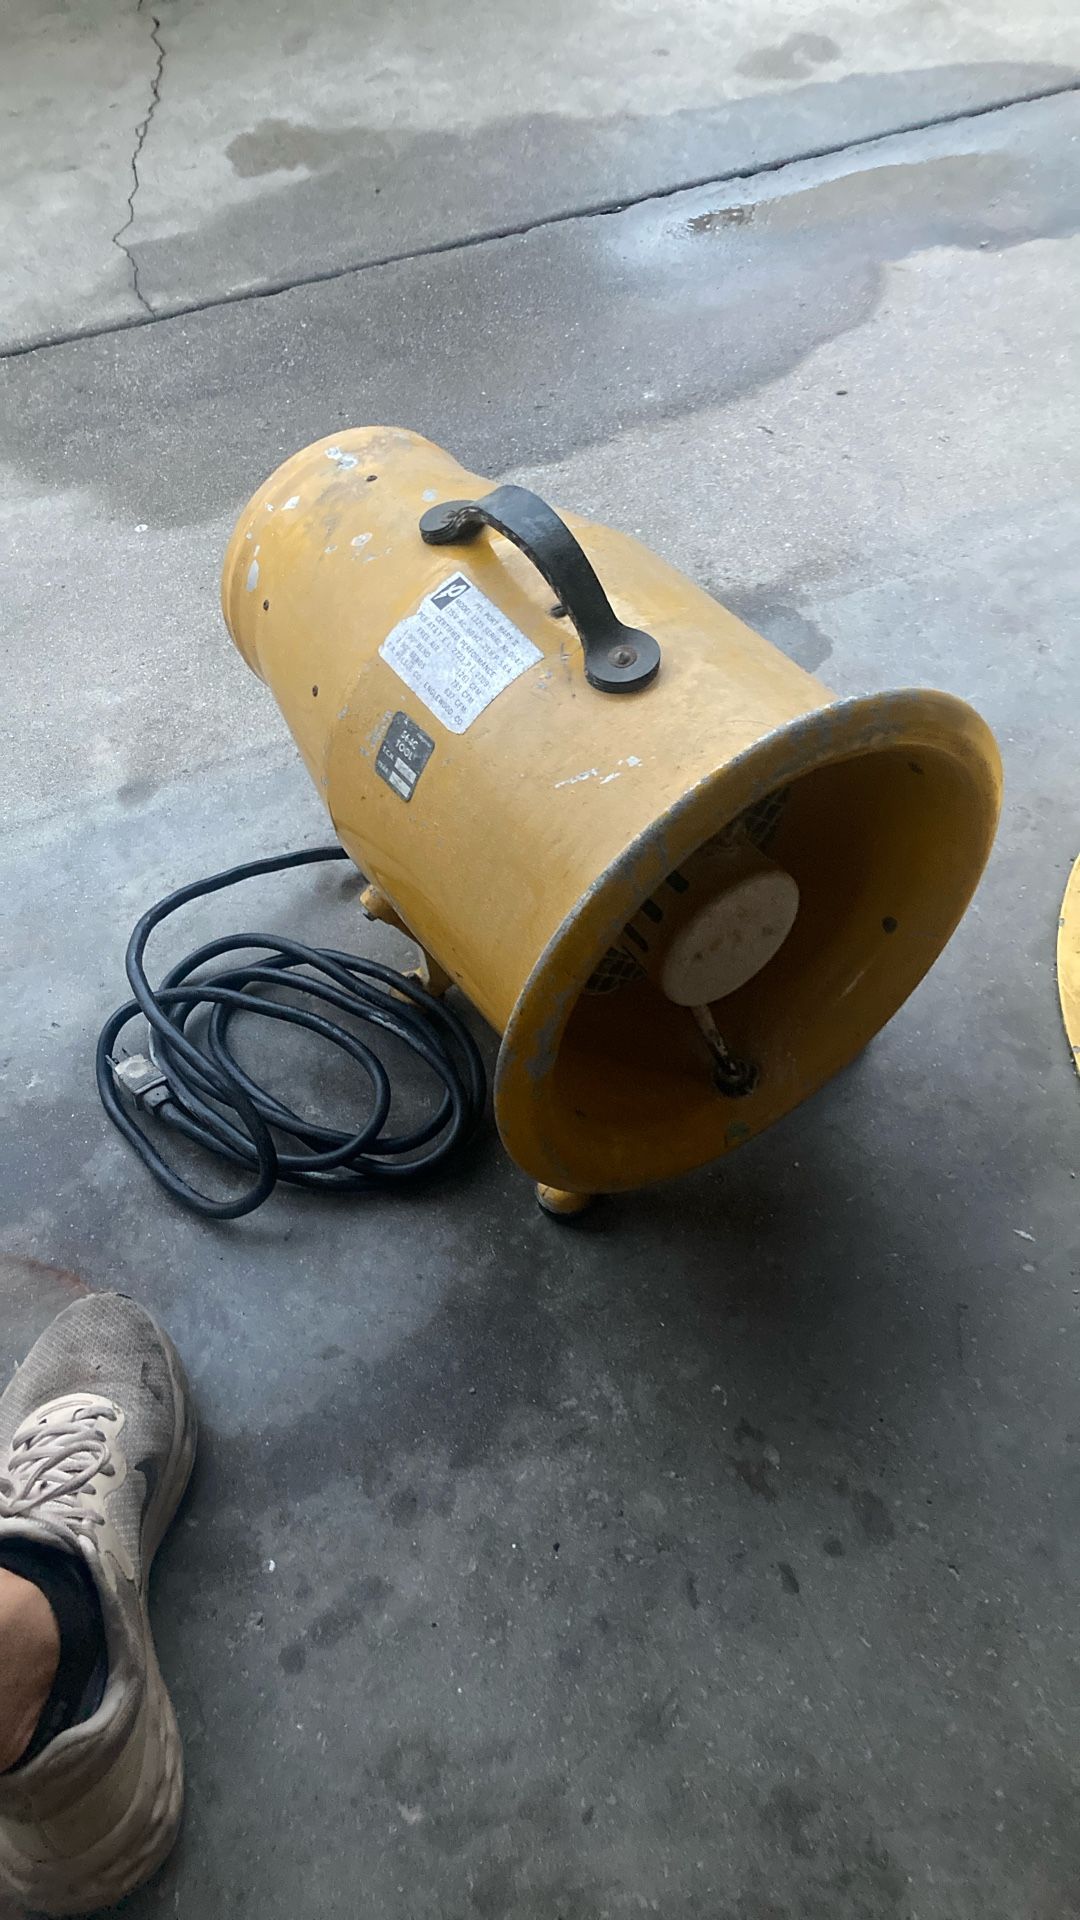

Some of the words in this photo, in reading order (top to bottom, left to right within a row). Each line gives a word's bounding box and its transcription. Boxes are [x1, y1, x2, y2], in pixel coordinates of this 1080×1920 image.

[454, 598, 472, 616] MODEL
[483, 626, 502, 646] SERIAL
[415, 627, 430, 641] FREE
[429, 641, 440, 651] AIR
[468, 682, 482, 696] CFM
[434, 614, 461, 641] CERTIFIED
[459, 639, 496, 678] PERFORMANCE
[422, 681, 455, 716] ENGLEWOOD
[453, 698, 469, 714] CFM
[460, 690, 475, 704] CFM
[394, 738, 414, 761] TOOL
